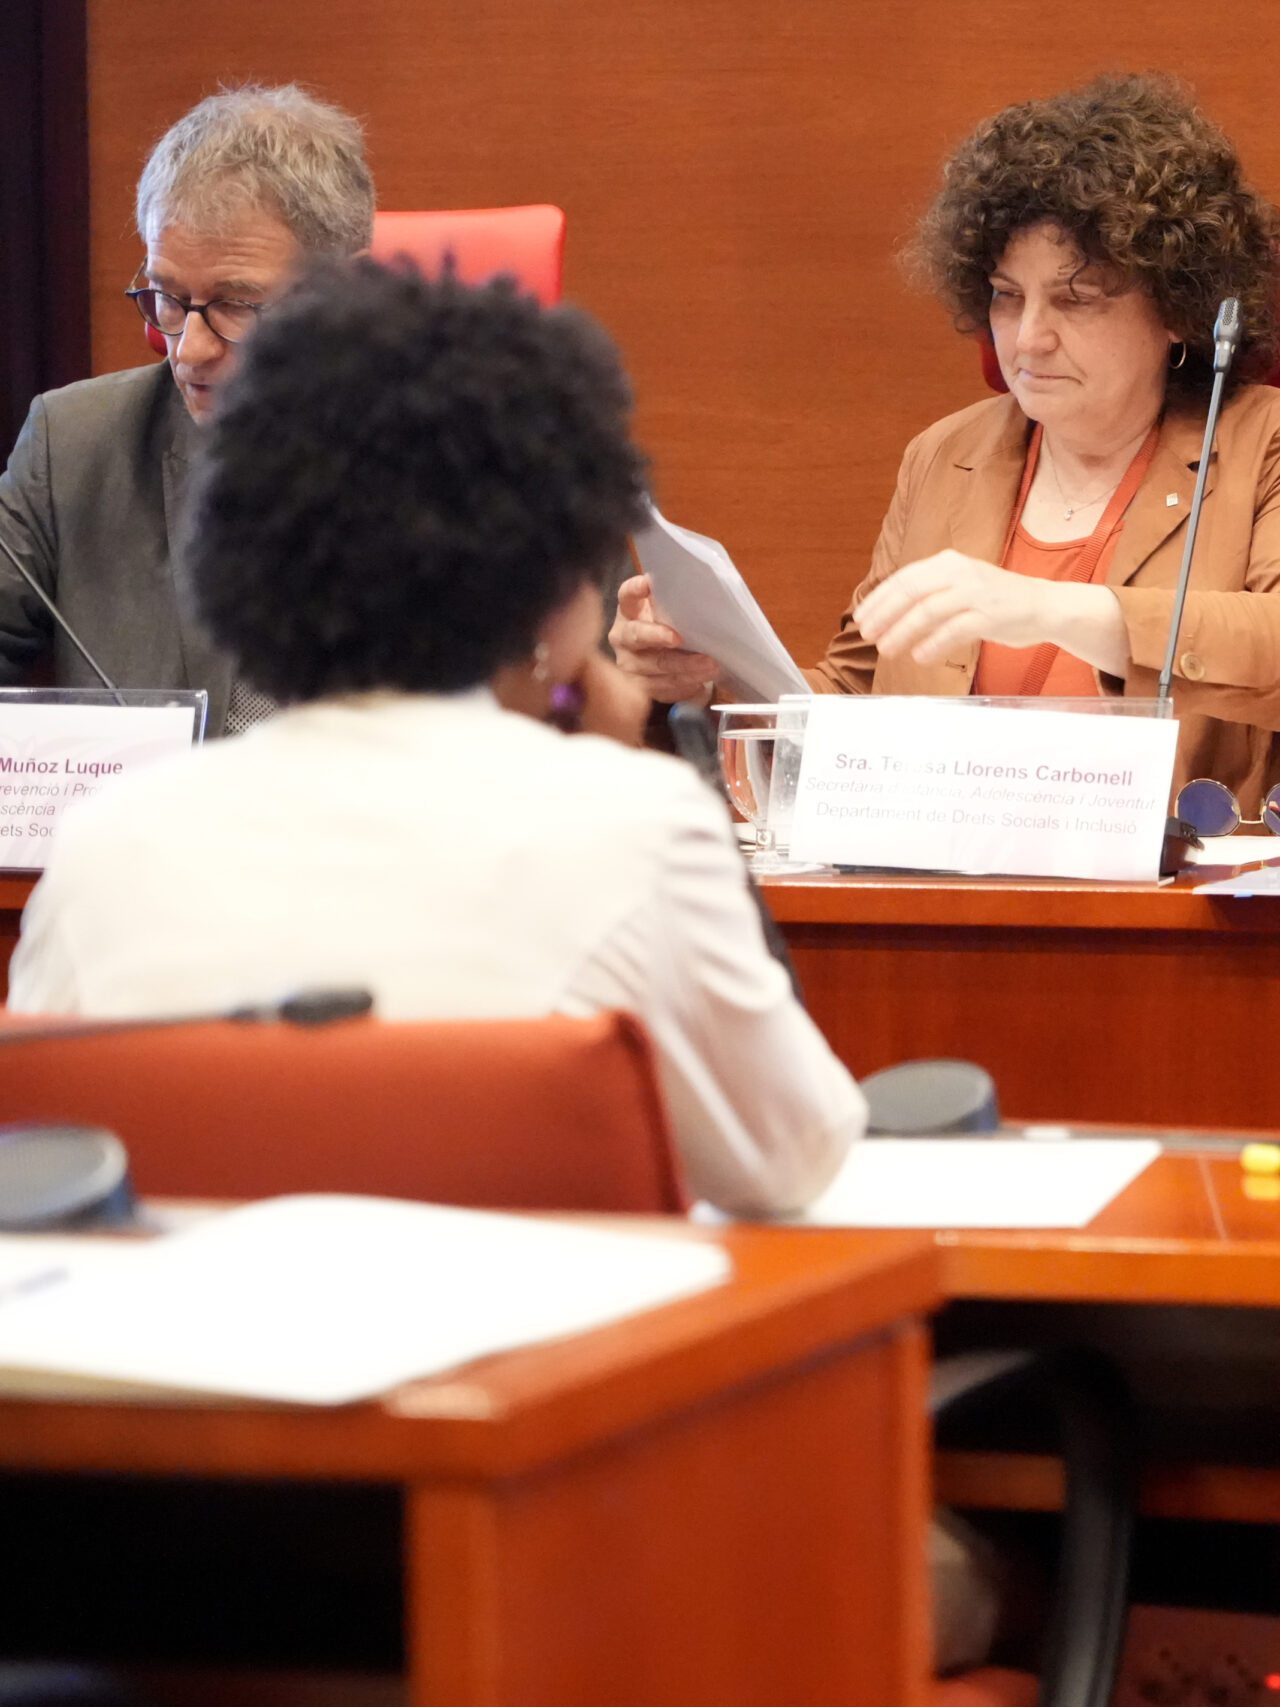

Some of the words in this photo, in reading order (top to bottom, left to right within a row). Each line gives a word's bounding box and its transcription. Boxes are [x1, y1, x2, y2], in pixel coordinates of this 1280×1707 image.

[0, 757, 59, 774] Muñoz
[65, 758, 123, 778] Luque
[835, 753, 872, 771] Sra.
[880, 755, 947, 775] Tesa
[953, 759, 1028, 780] Llorens
[1035, 764, 1133, 787] Carbonell
[63, 784, 70, 797] i
[72, 783, 102, 798] Pro
[1088, 794, 1157, 811] Joventut
[816, 801, 921, 824] Departament
[926, 808, 946, 823] de
[952, 808, 996, 825] Drets
[1001, 812, 1060, 830] Socials
[1075, 818, 1137, 835] Inclusió
[0, 823, 23, 837] ets
